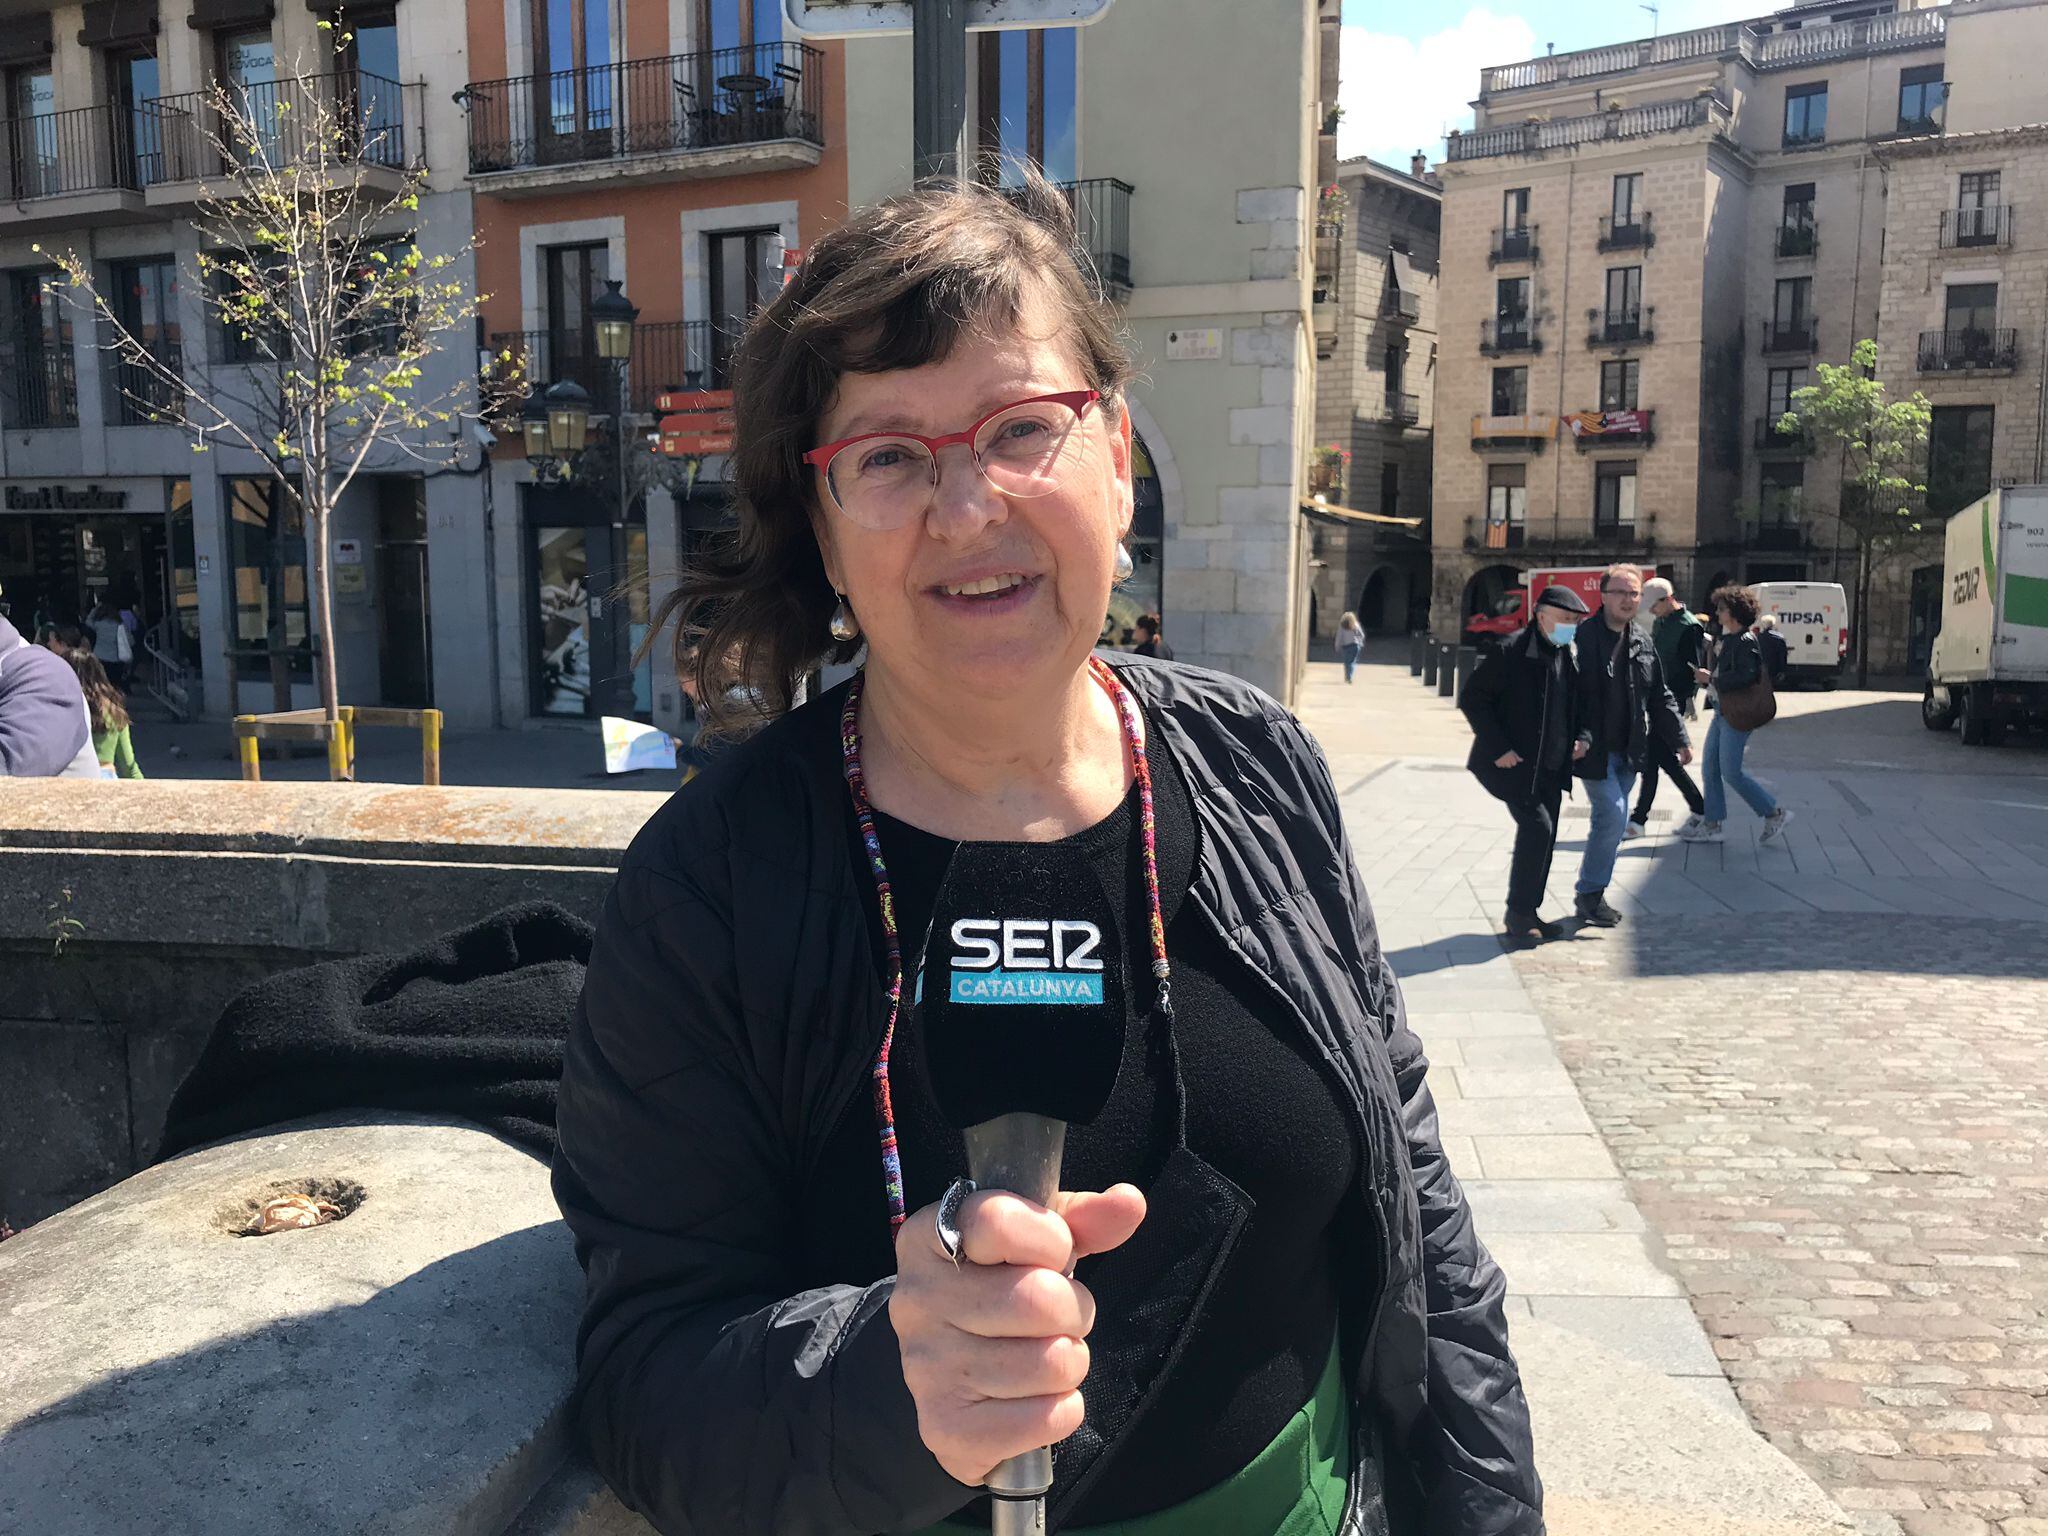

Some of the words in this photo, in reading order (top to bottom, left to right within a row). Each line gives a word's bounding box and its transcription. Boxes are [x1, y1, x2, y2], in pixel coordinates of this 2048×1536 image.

[1777, 612, 1824, 624] TIPSA
[951, 919, 1104, 969] SER
[957, 979, 1093, 997] CATALUNYA
